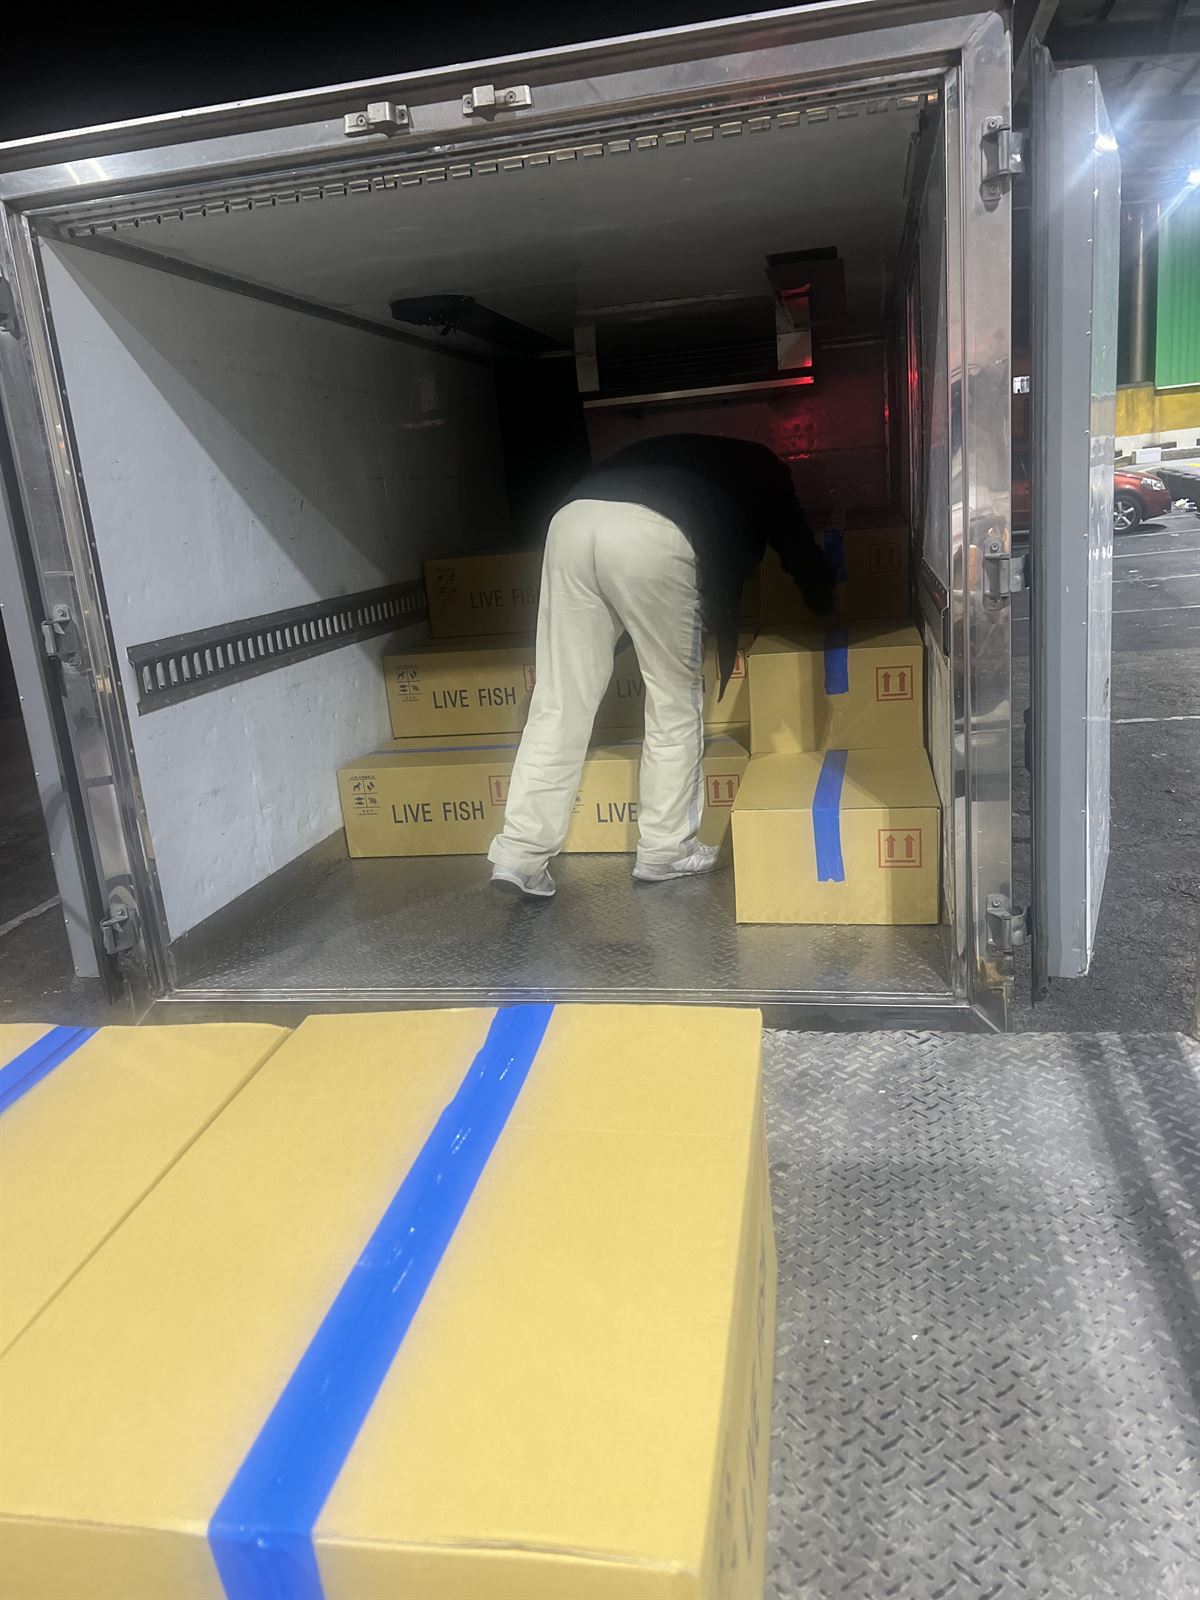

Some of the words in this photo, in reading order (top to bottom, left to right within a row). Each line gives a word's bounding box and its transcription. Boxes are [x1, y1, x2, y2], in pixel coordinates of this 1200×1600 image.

[469, 590, 504, 609] LIVE
[512, 586, 538, 607] FIS
[432, 689, 470, 709] LIVE
[478, 686, 516, 706] FISH
[616, 679, 644, 698] LIV
[391, 802, 433, 824] LIVE
[442, 800, 485, 821] FISH
[596, 802, 638, 823] LIVE
